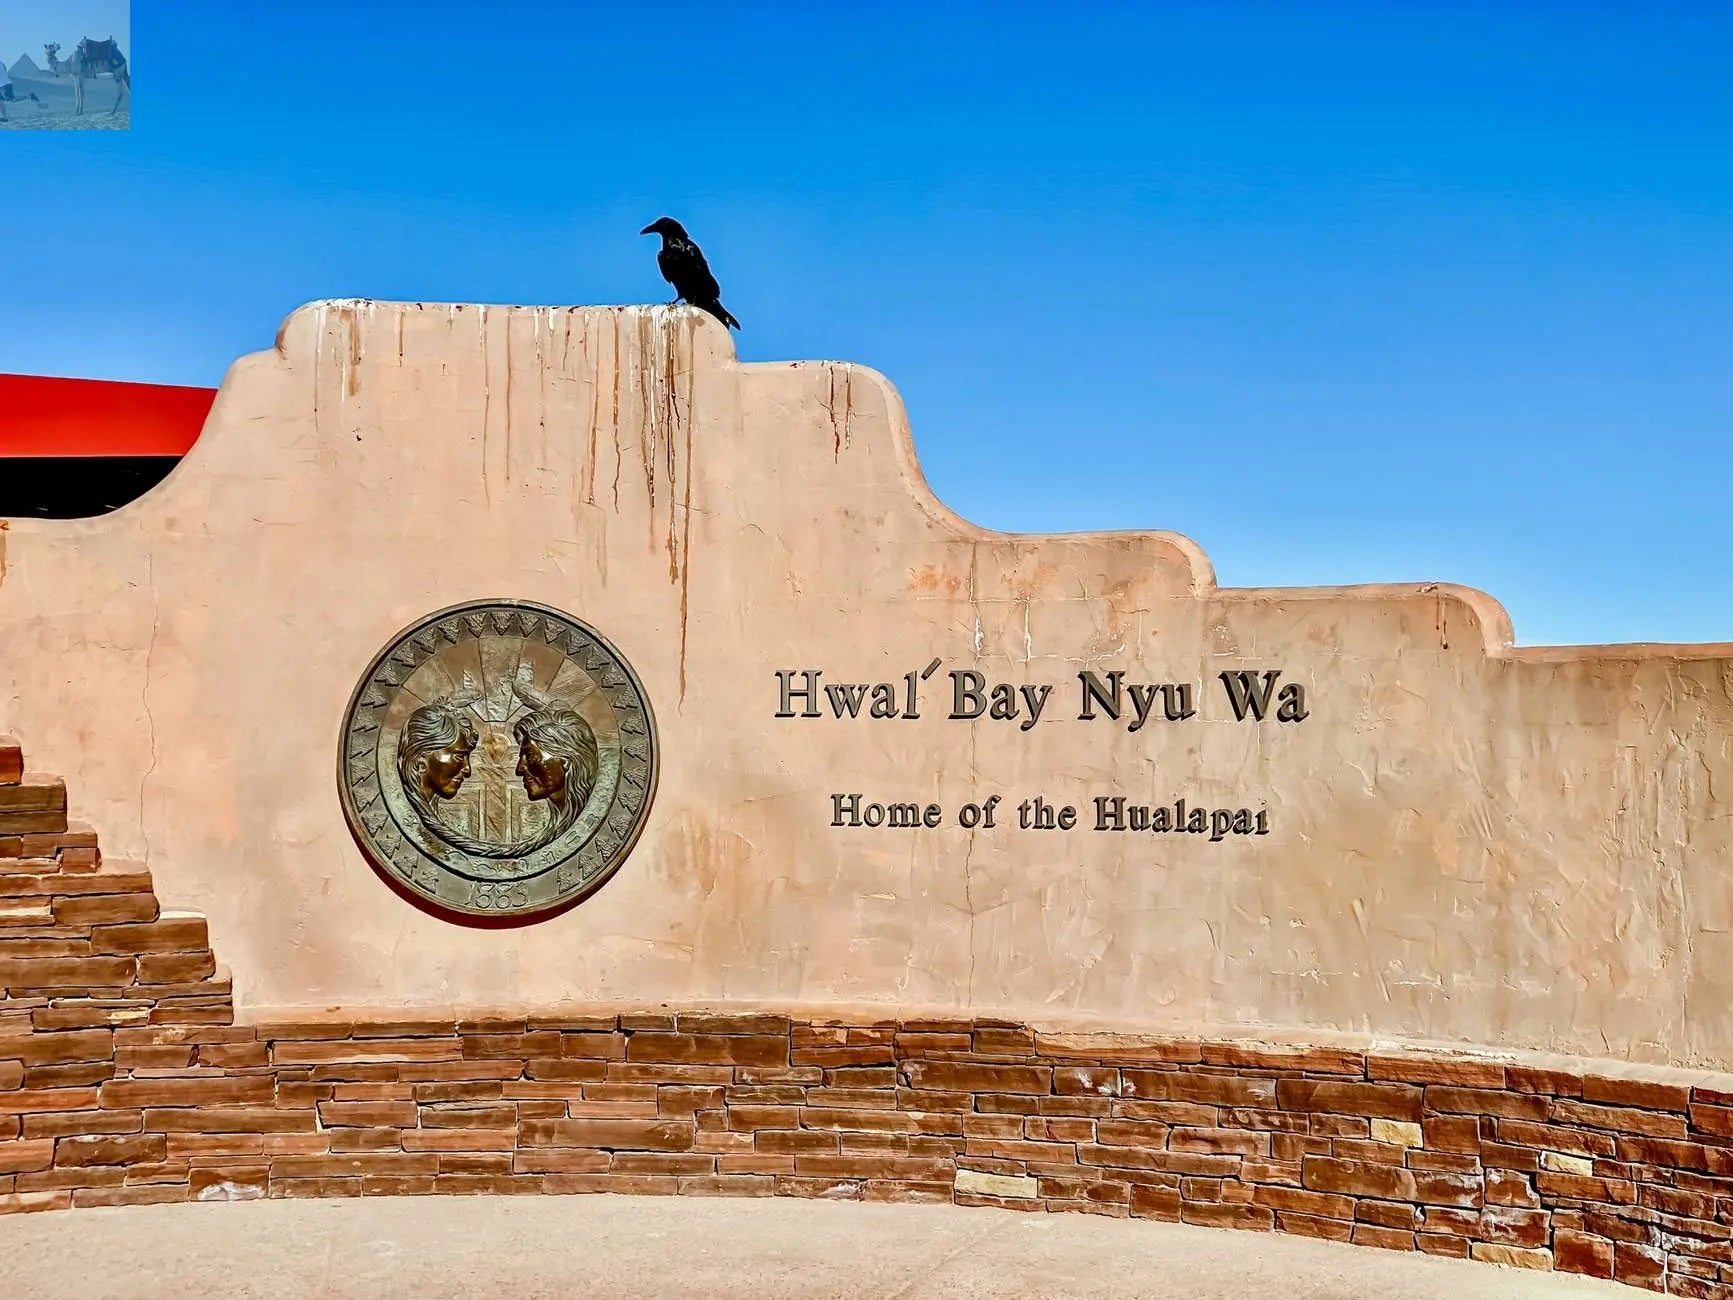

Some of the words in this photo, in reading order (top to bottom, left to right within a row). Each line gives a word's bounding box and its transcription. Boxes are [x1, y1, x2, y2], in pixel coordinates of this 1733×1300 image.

[948, 669, 1055, 731] Bay
[1077, 670, 1196, 732] Nyu
[1218, 669, 1310, 723] Wa
[830, 793, 942, 828] Home
[958, 795, 1002, 828] of
[1018, 797, 1078, 830] the
[1093, 796, 1271, 842] Hualapai
